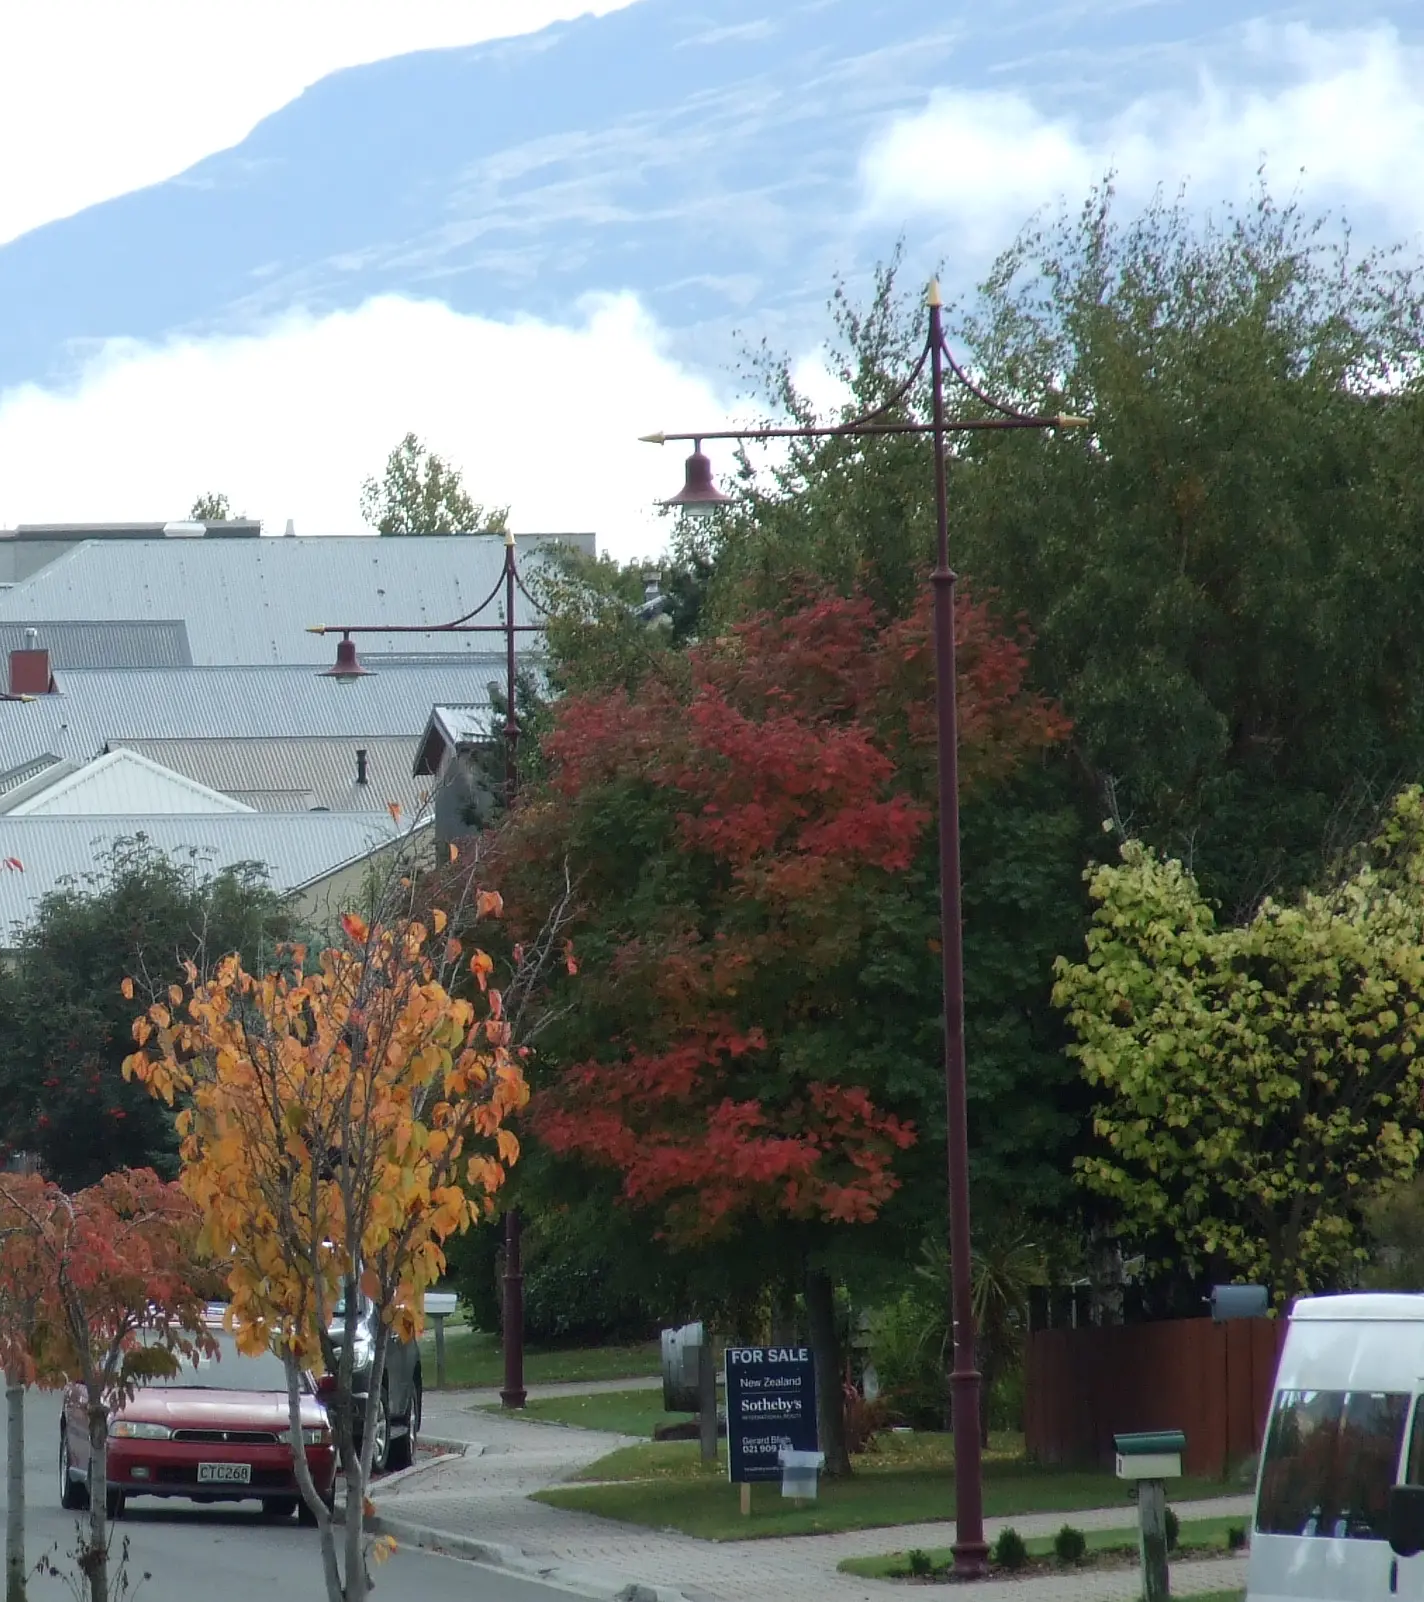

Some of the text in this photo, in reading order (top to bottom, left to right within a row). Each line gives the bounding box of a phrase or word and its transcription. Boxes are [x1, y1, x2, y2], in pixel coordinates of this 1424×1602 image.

[731, 1348, 809, 1364] FOR SALE
[740, 1376, 802, 1388] New Zealand
[741, 1397, 802, 1413] Sotheby's
[200, 1466, 248, 1479] CTC268
